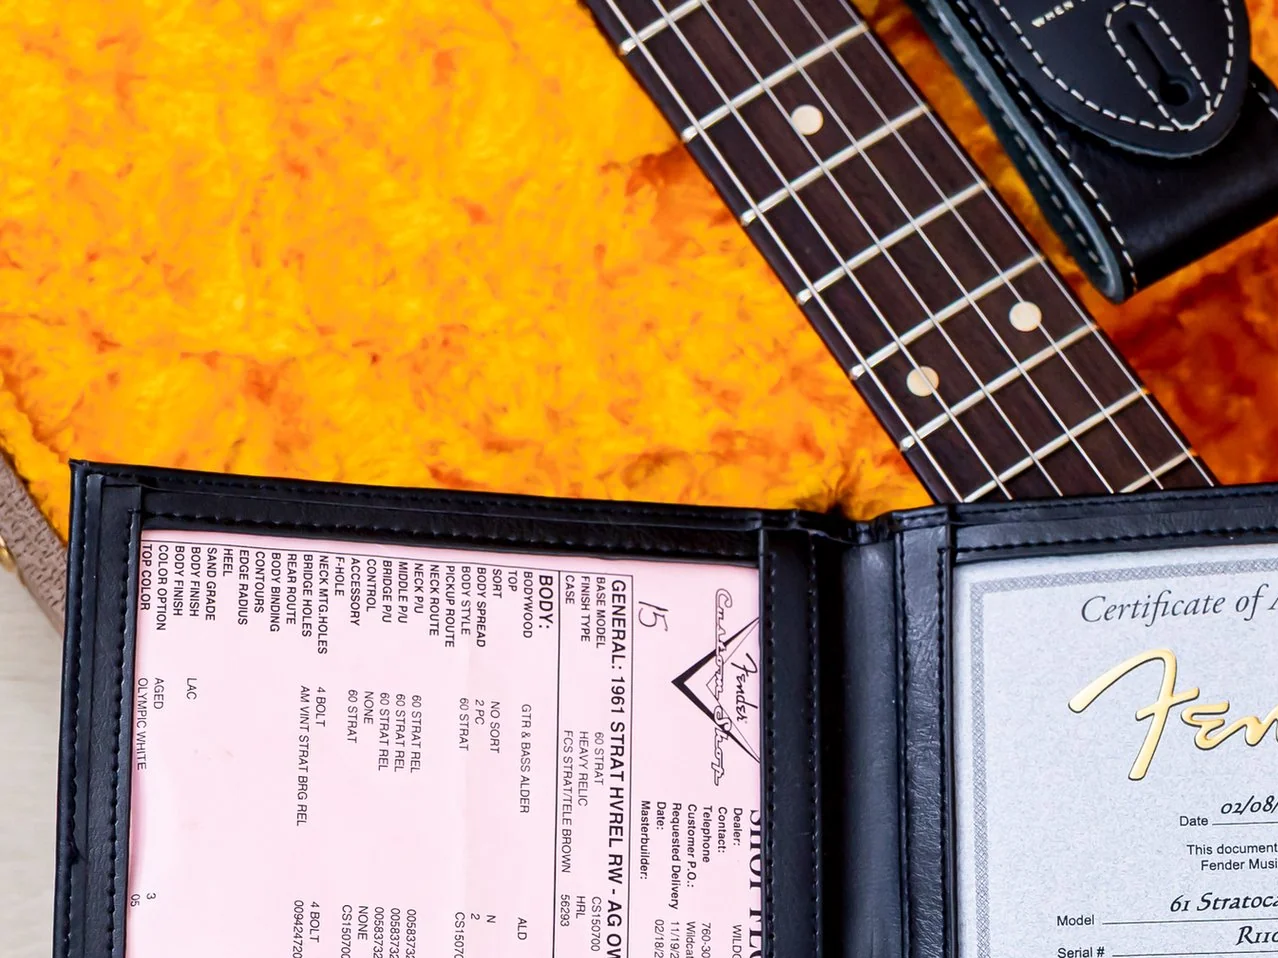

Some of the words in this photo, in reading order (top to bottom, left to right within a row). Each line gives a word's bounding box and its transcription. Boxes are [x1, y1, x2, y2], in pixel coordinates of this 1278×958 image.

[414, 563, 424, 593] NECK
[414, 596, 424, 613] P/U
[539, 575, 553, 628] BODY:
[638, 600, 669, 632] 15
[1081, 590, 1225, 627] Certificate
[1235, 584, 1268, 621] of
[612, 580, 626, 669] GENERAL:
[715, 589, 733, 701] Custom
[137, 678, 148, 728] OLYMPIC
[412, 695, 422, 708] 60
[611, 676, 625, 713] 1961
[731, 653, 759, 724] Fender
[411, 711, 422, 748] STRAT
[711, 705, 732, 787] Shop
[137, 731, 146, 770] WHITE
[410, 752, 421, 773] REL
[610, 721, 625, 782] STRAT
[609, 787, 624, 848] HVREL
[670, 803, 682, 861] Requested
[701, 805, 712, 863] Telephone
[733, 808, 743, 846] Dealer:
[1180, 816, 1208, 826] Date
[1186, 844, 1213, 855] This
[1217, 843, 1278, 854] document
[1201, 859, 1245, 871] Fender
[608, 854, 623, 884] RW
[668, 865, 681, 909] Delivery
[607, 900, 622, 926] AG
[1057, 914, 1094, 926] Model
[1170, 895, 1191, 912] 61
[591, 897, 602, 951] CS150700
[1057, 947, 1092, 958] Serial
[1097, 946, 1105, 957] #
